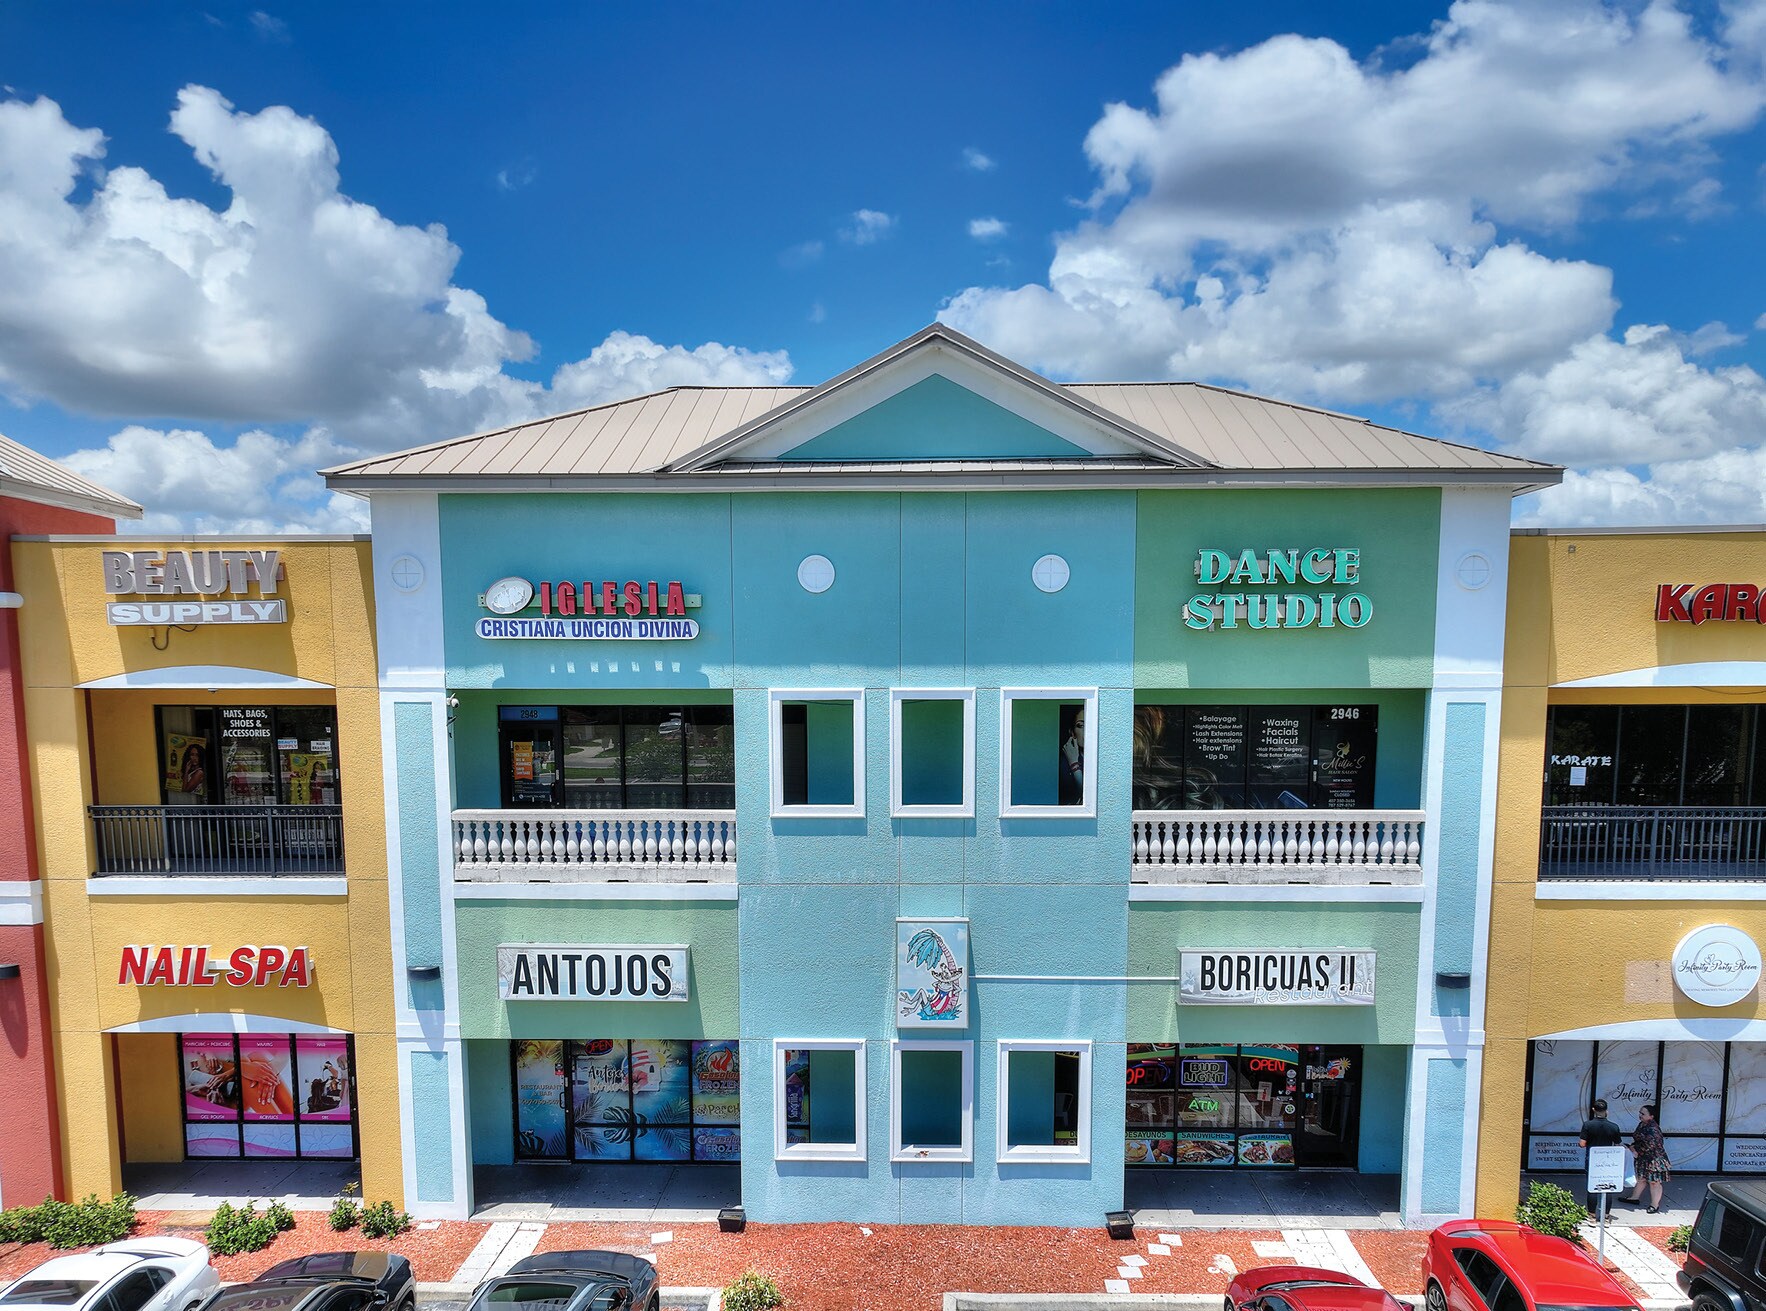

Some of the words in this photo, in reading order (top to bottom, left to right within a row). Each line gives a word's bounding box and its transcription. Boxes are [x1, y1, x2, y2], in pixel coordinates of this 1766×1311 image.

[102, 551, 281, 594] BEAUTY
[1198, 548, 1360, 585] DANCE
[540, 580, 686, 616] IGLESIA
[1656, 583, 1766, 626] KAR
[111, 603, 276, 623] SUPPLY
[1185, 593, 1373, 629] STUDIO
[480, 619, 566, 638] CRISTIANA
[571, 620, 633, 638] UNCION
[638, 621, 693, 638] DIVINA
[223, 710, 245, 719] HATS,
[245, 710, 268, 719] BAGS,
[520, 709, 538, 718] 2948
[1202, 715, 1237, 723] Balayage
[1330, 708, 1360, 720] 2946
[230, 719, 254, 727] SHOES
[255, 719, 262, 727] &
[1266, 718, 1299, 728] Waxing
[223, 729, 271, 737] ACCESSORIES
[1266, 727, 1299, 736] Facials
[1265, 736, 1299, 745] Haircut
[1550, 755, 1612, 767] KARATE
[118, 945, 219, 986] NAIL
[225, 945, 310, 987] SPA
[1200, 954, 1330, 992] BORICUAS
[1678, 960, 1709, 974] Infinity
[1710, 960, 1736, 973] Party
[1734, 960, 1758, 972] Room
[511, 953, 674, 997] ANTOJOS
[1253, 978, 1373, 1004] Restaurant
[586, 1040, 613, 1054] OPEN
[1190, 1062, 1220, 1072] BUD
[1250, 1058, 1285, 1072] OPEN
[1184, 1071, 1225, 1083] LIGHT
[1612, 1083, 1656, 1102] Infinity
[1661, 1086, 1693, 1102] Party
[1691, 1085, 1722, 1101] Room
[1188, 1099, 1219, 1112] ATM
[1181, 1131, 1231, 1139] SANDWICHES
